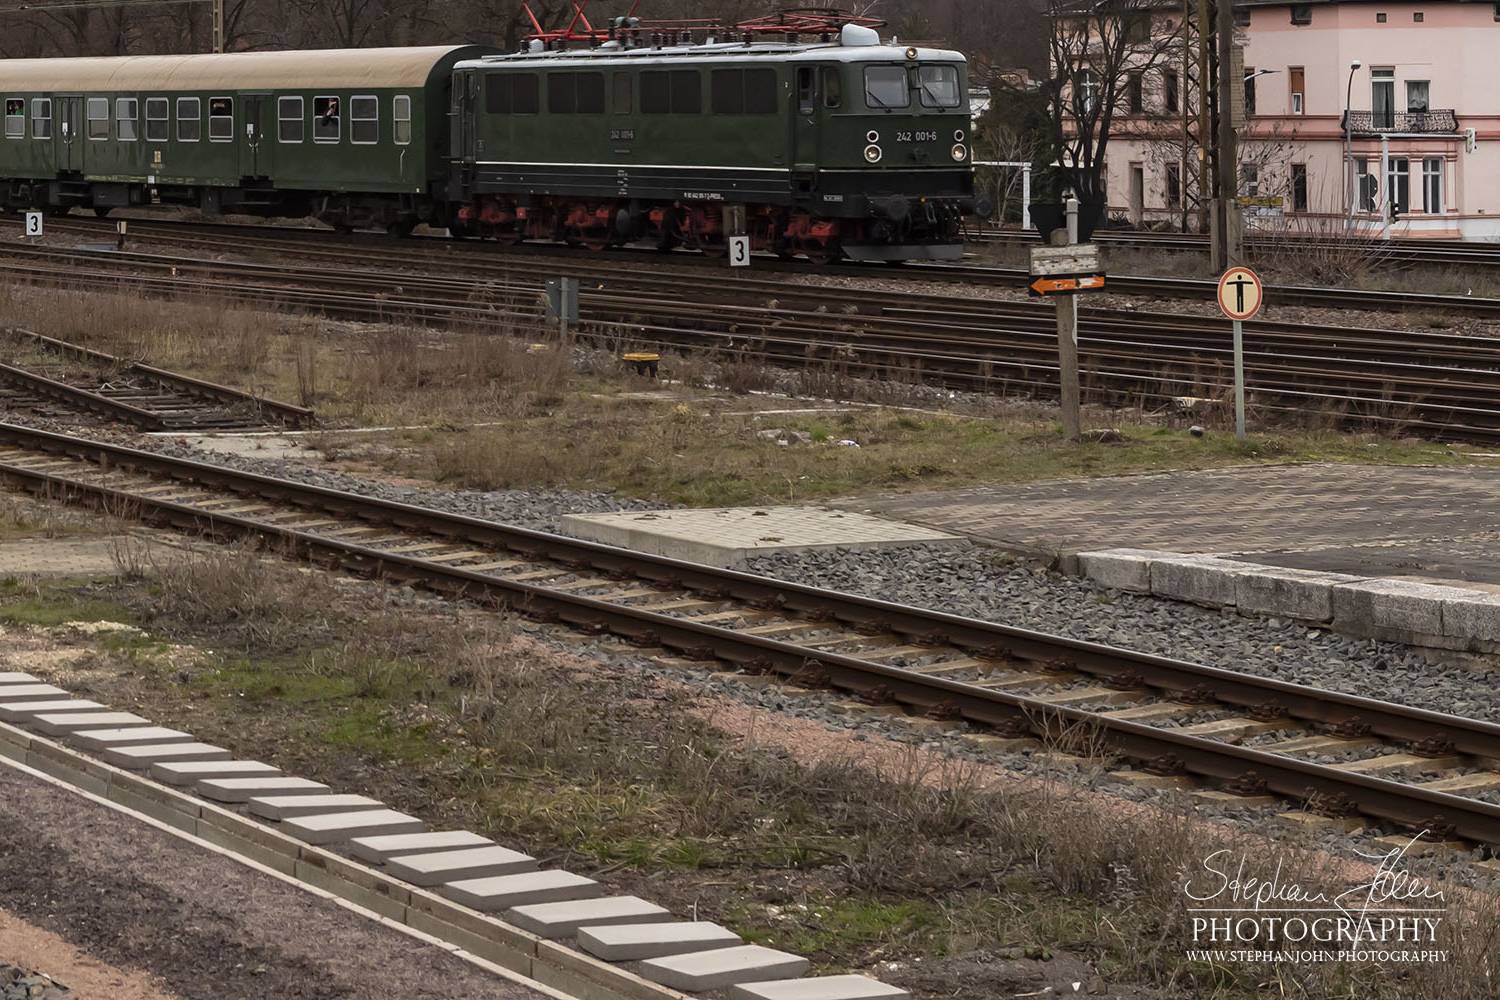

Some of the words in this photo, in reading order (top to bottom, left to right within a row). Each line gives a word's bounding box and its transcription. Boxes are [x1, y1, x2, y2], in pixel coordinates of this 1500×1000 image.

[896, 132, 912, 142] 242
[915, 131, 937, 141] 001-6
[30, 215, 38, 232] 3
[735, 240, 745, 262] 3
